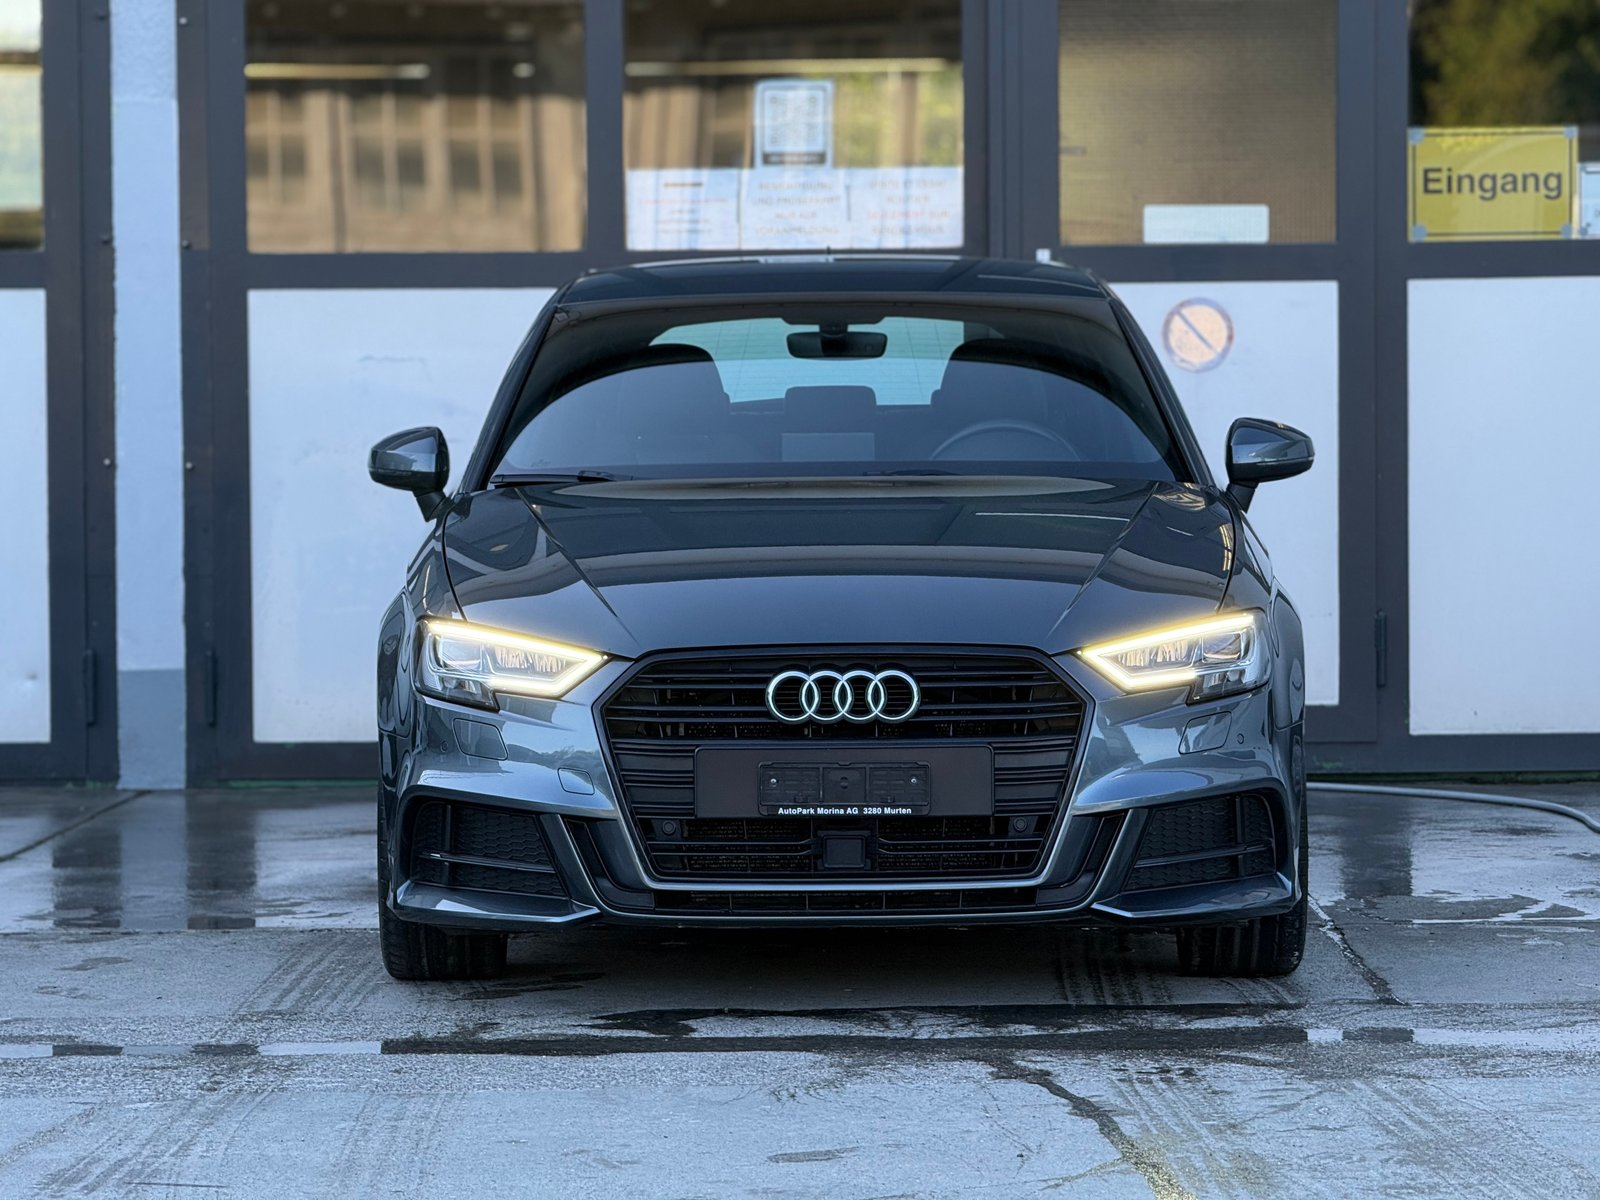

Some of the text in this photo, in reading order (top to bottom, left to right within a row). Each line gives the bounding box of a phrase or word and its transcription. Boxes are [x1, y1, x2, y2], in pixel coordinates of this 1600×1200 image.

[1423, 167, 1562, 200] Eingang
[777, 807, 912, 815] AutoPark Morina AG 3280 Murten
